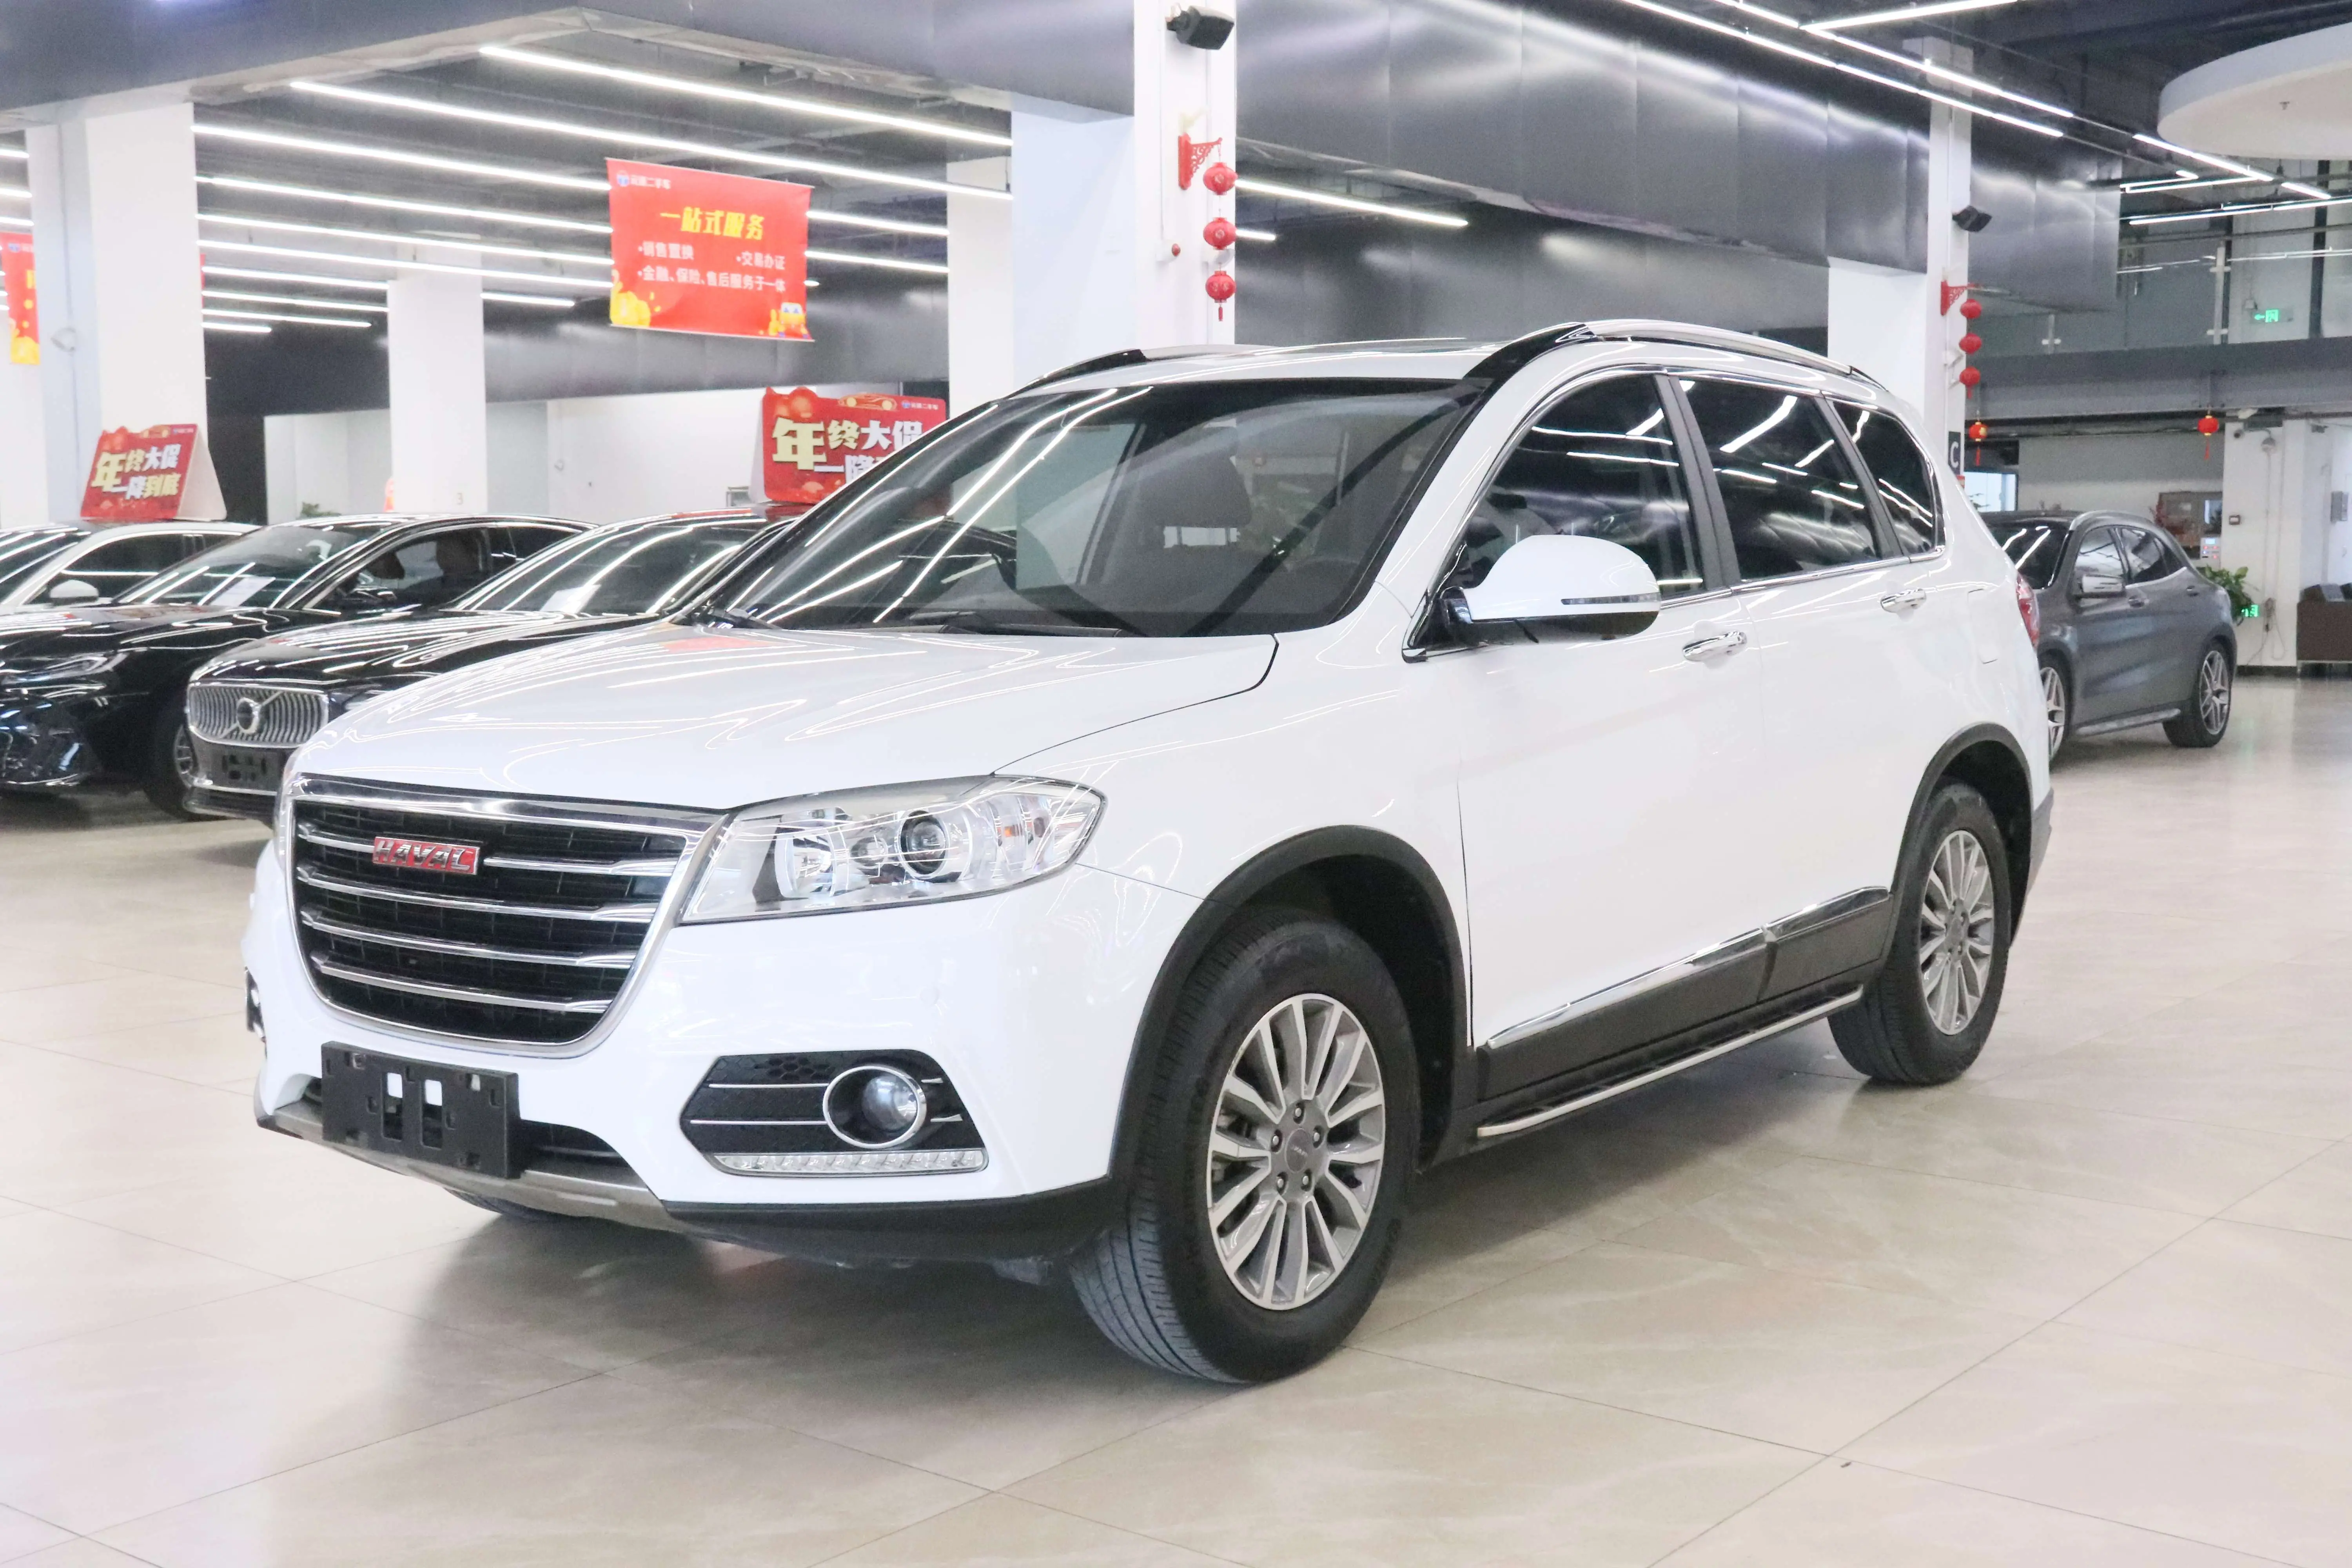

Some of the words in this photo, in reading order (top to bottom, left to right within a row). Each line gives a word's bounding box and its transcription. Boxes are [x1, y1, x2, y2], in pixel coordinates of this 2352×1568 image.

[660, 206, 764, 240] 一站式服务
[741, 251, 786, 270] 交易办证
[1950, 441, 1959, 468] C
[374, 840, 471, 870] HAVAL
